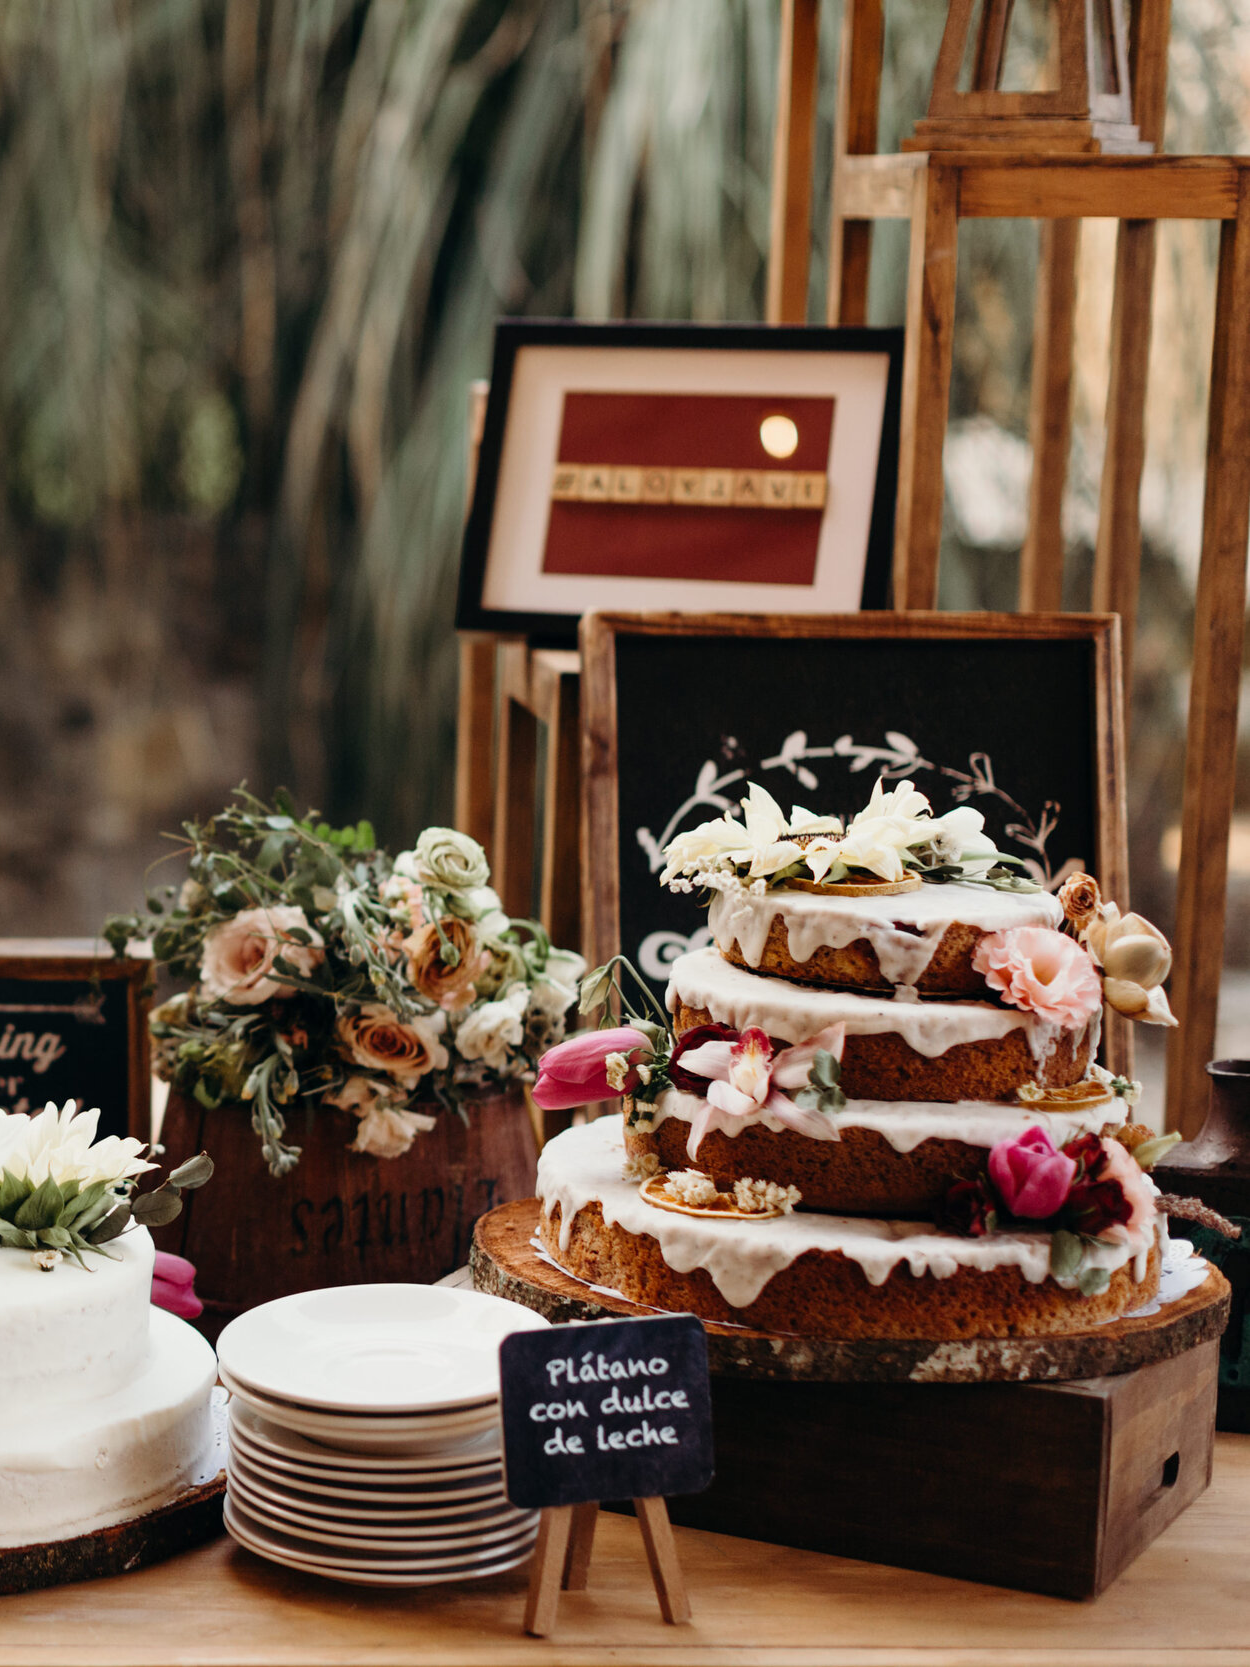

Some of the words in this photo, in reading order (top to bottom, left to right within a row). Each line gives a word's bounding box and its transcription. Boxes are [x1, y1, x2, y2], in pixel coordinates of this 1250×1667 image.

[546, 1351, 669, 1387] Plátano
[529, 1399, 589, 1422] con
[600, 1384, 690, 1415] dulce
[543, 1426, 586, 1456] de
[596, 1420, 679, 1451] leche
